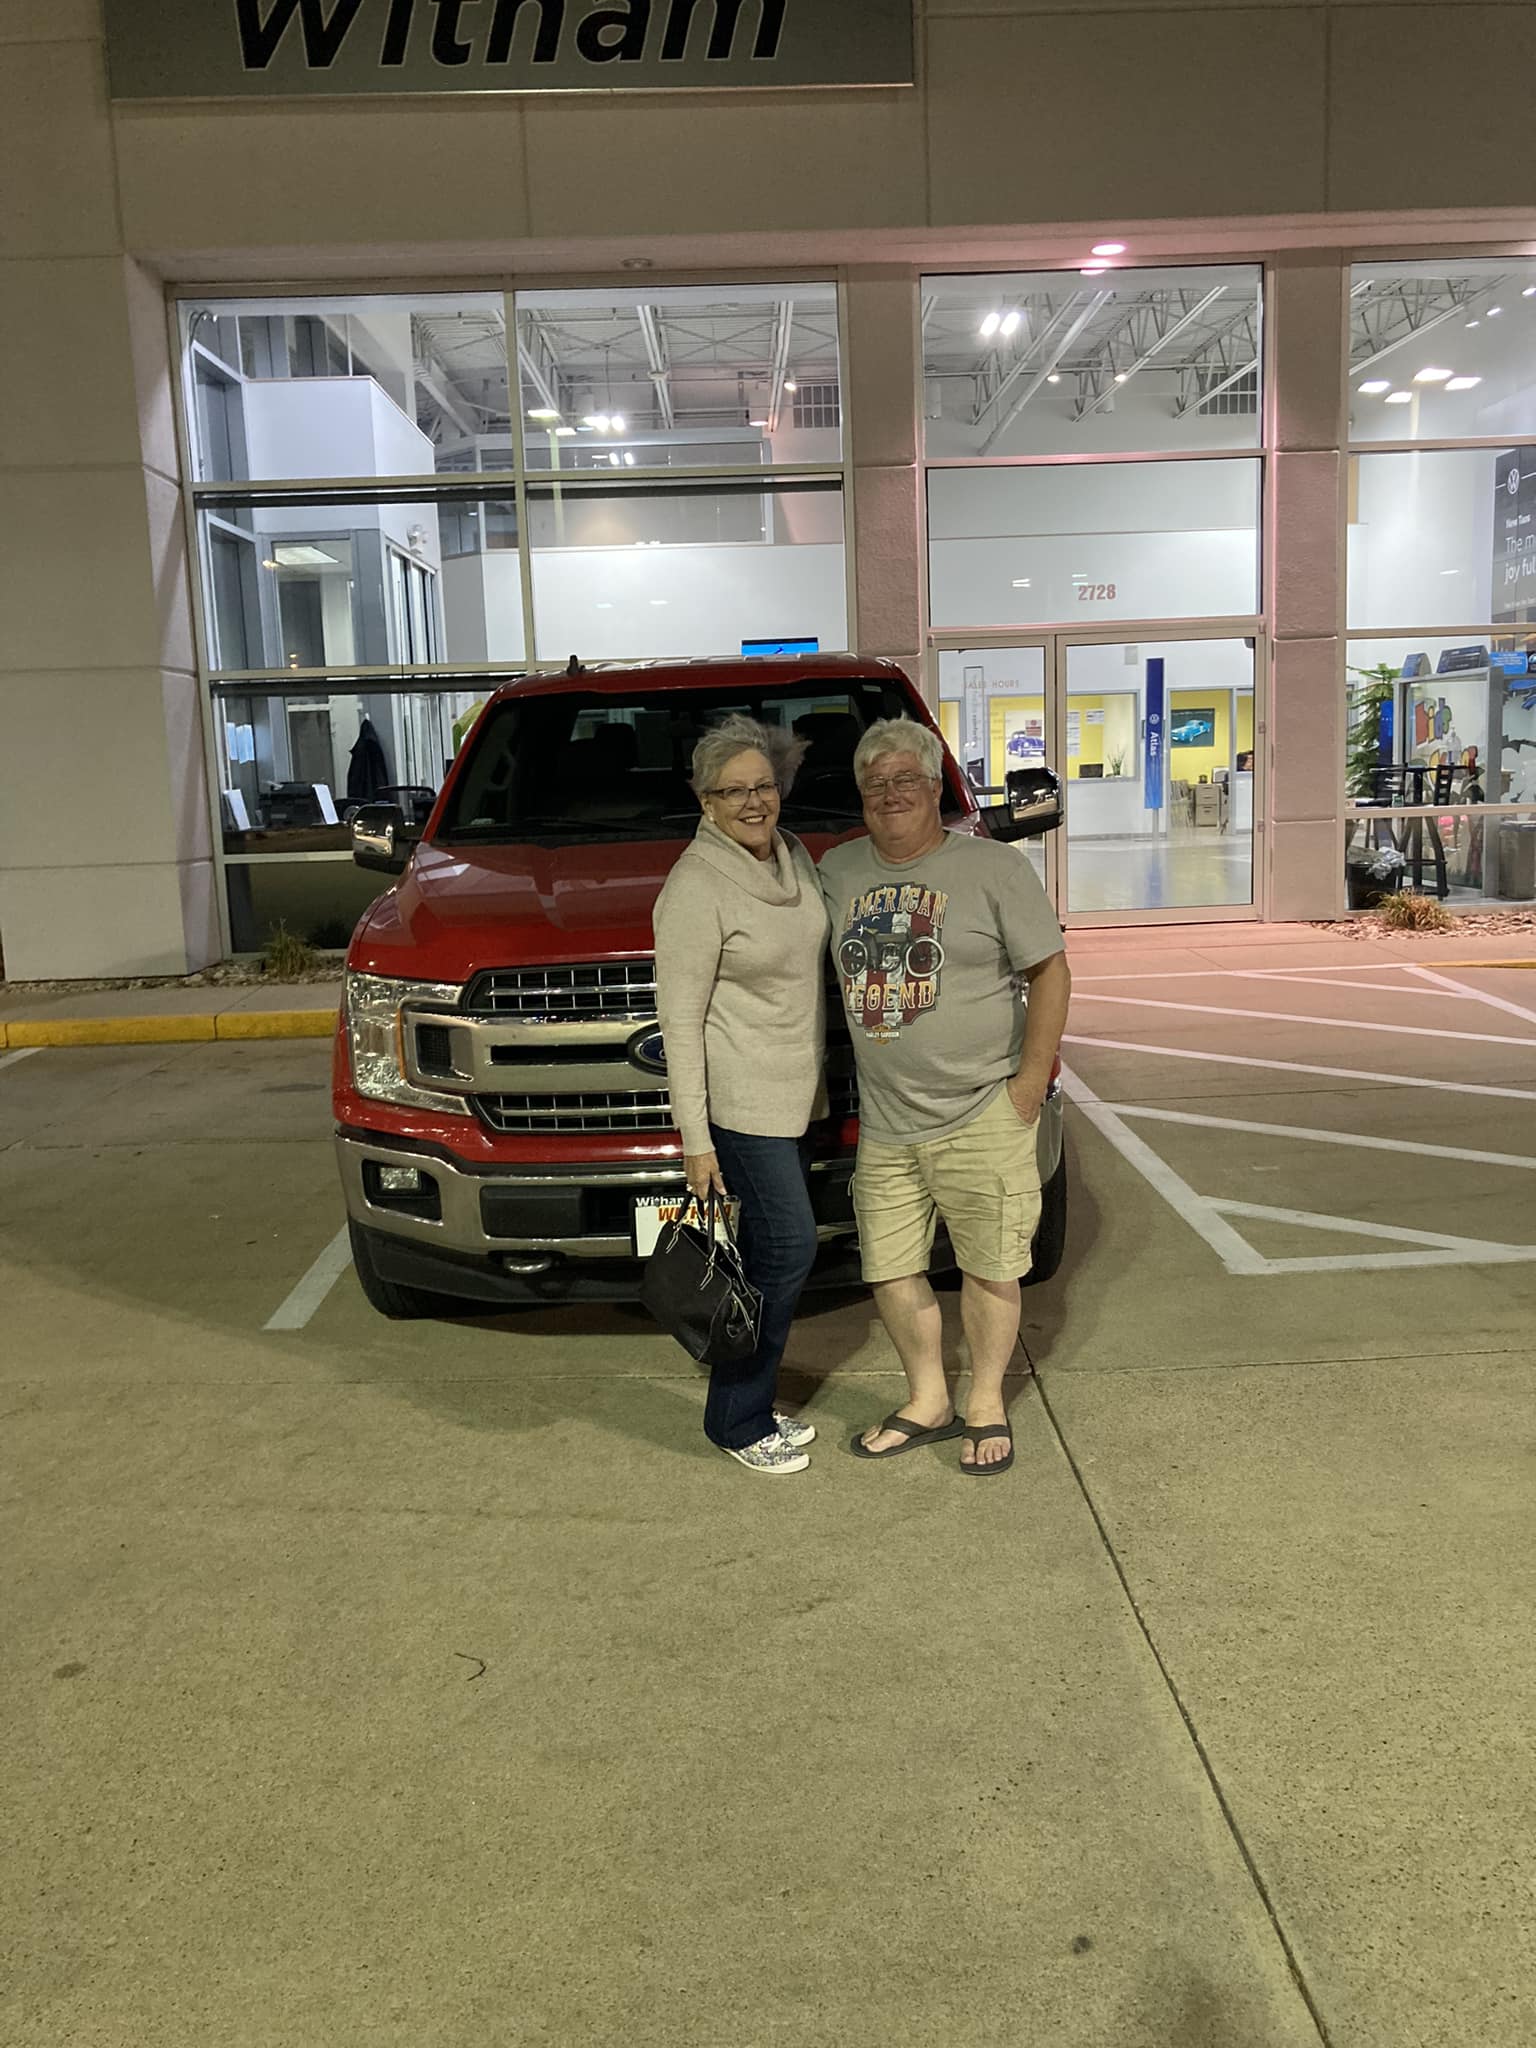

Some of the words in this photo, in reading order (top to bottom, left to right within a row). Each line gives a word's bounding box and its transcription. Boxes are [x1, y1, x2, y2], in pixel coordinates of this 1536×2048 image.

[1504, 536, 1522, 553] The
[1078, 584, 1116, 601] 2728
[992, 680, 1019, 689] HOURS
[1150, 731, 1160, 757] Atlas
[847, 886, 949, 929] AMERICAN
[846, 981, 937, 1010] LEGEND
